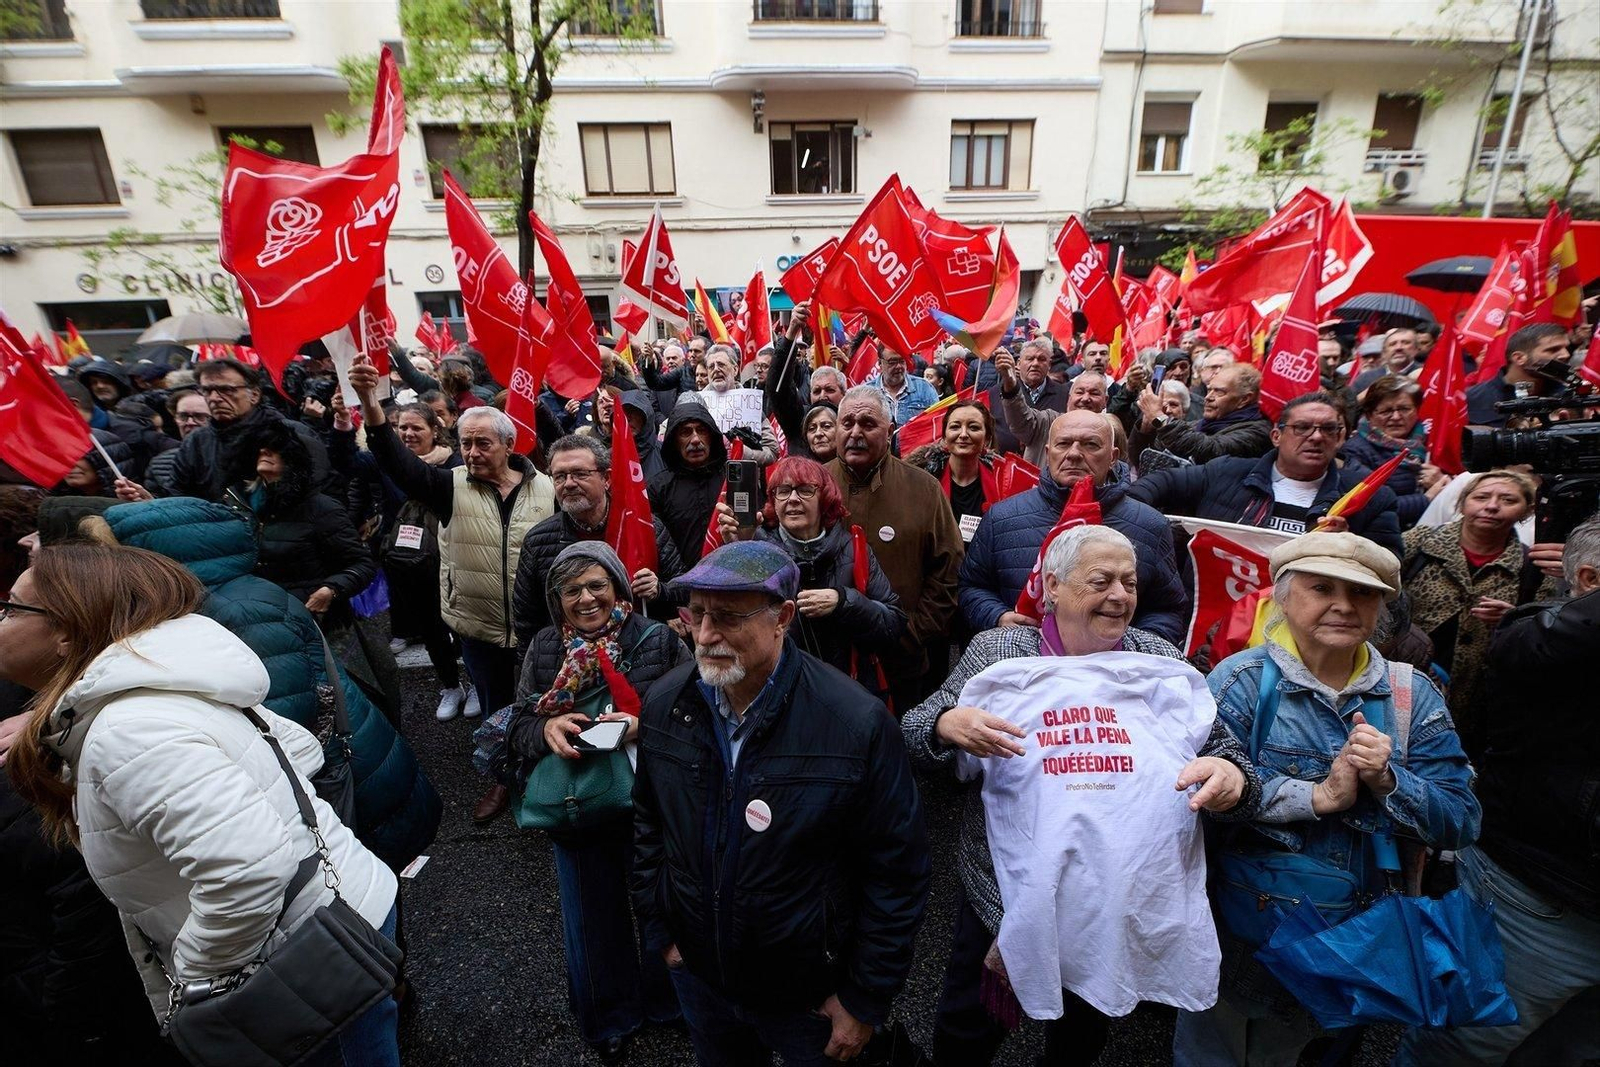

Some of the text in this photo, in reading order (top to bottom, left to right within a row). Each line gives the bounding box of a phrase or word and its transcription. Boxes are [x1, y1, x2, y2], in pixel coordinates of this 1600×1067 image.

[858, 223, 908, 290] PSOE
[1043, 706, 1118, 727] CLARO QUE
[1036, 727, 1131, 748] VALE LA PENA
[1042, 752, 1134, 776] ¡QUÉÉÉDATE!
